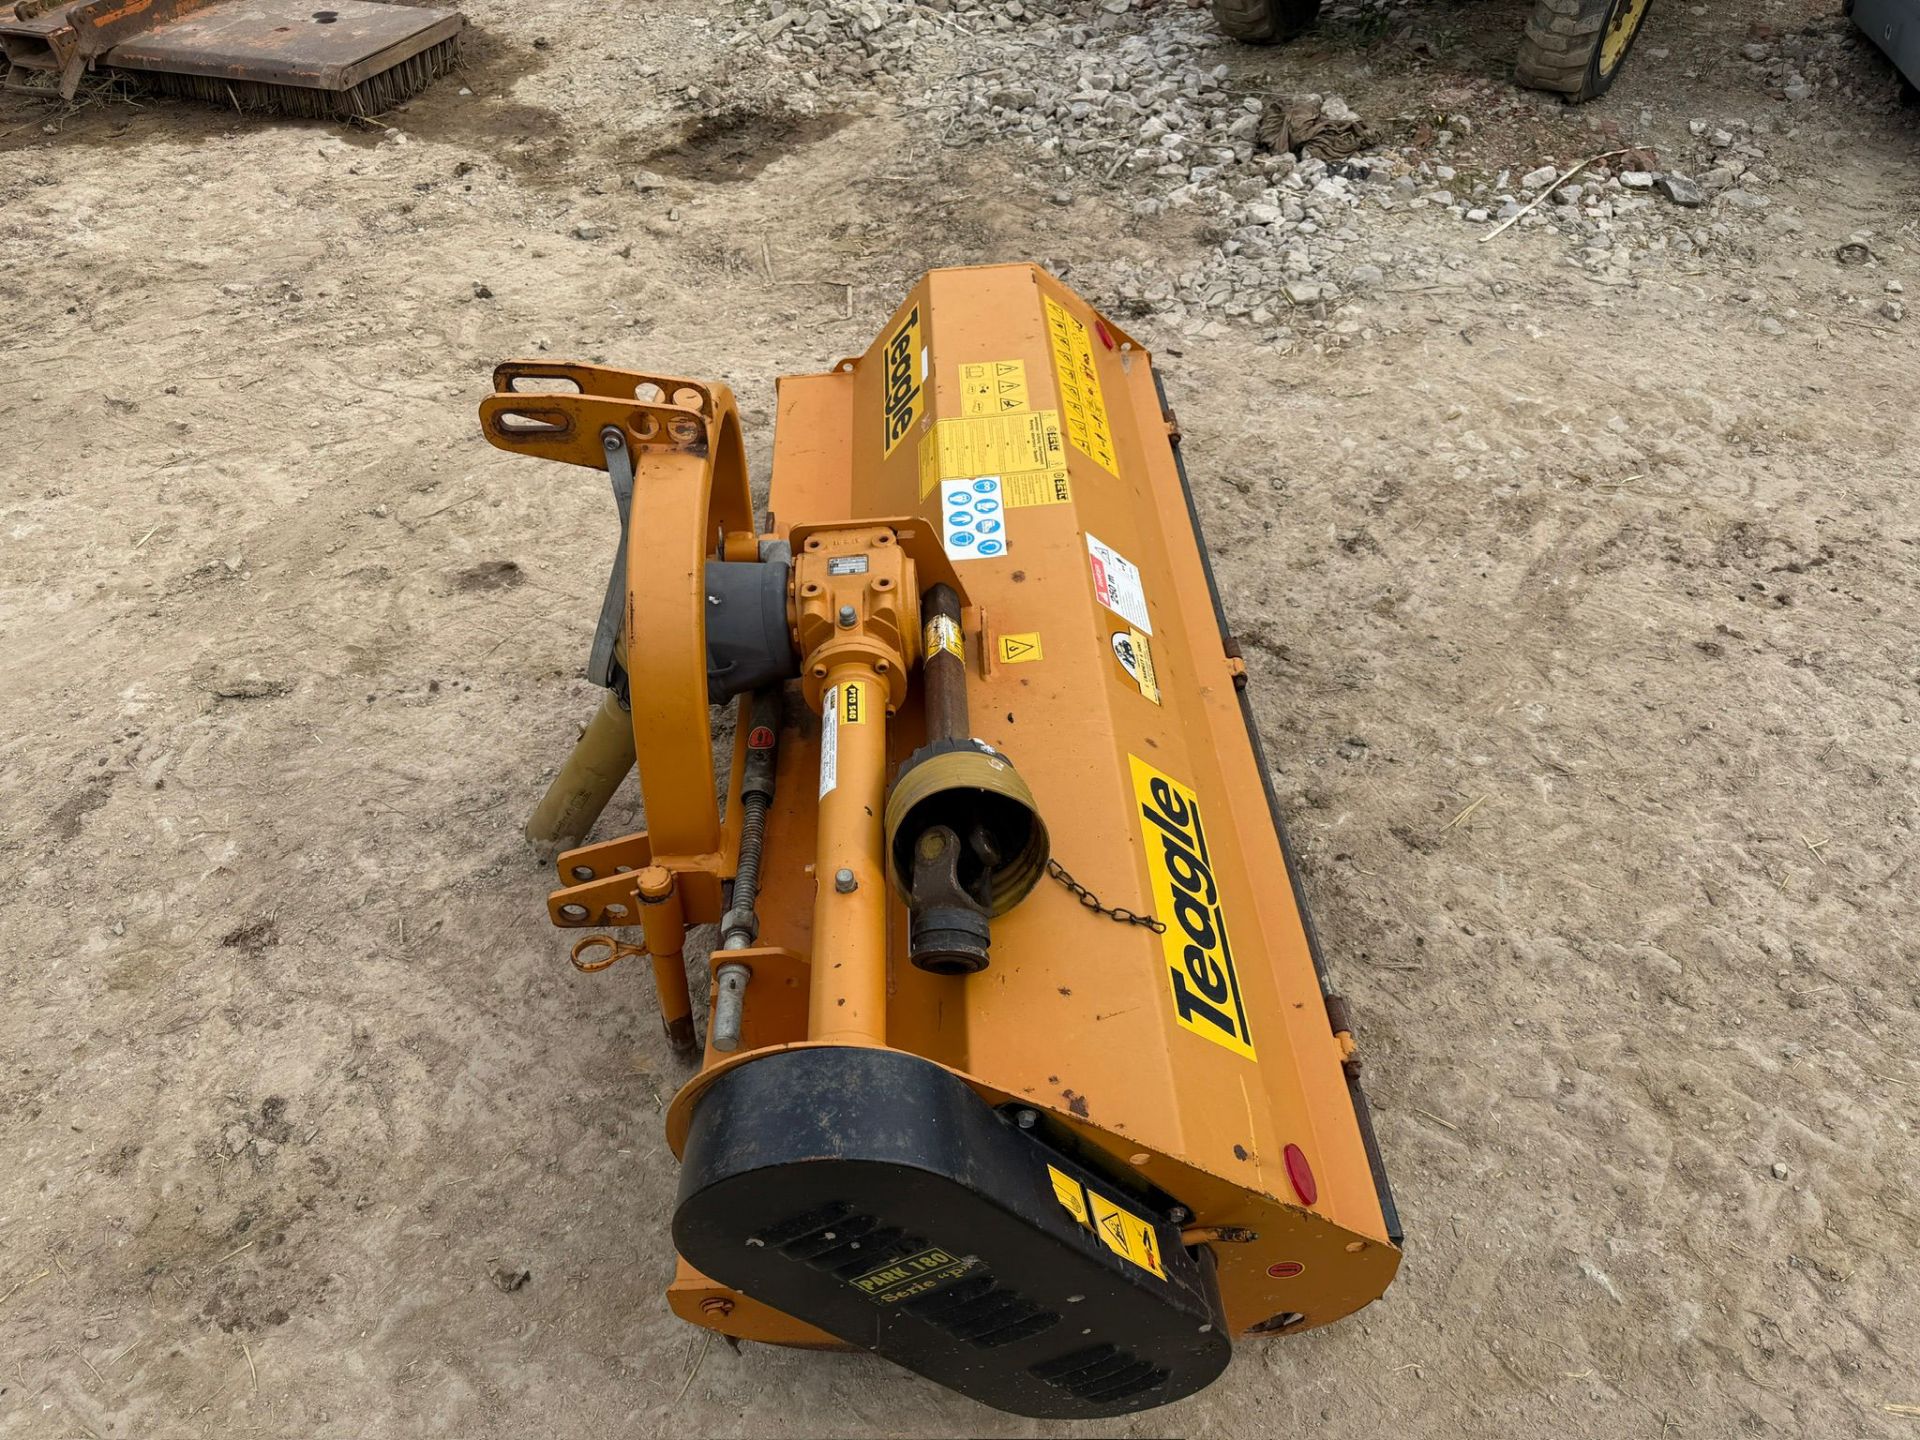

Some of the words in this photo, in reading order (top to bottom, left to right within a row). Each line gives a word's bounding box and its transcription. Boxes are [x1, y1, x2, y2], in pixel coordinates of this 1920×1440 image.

[885, 306, 920, 440] Teagle
[848, 688, 857, 703] PTO
[848, 705, 857, 719] 540
[1142, 777, 1237, 1038] Teagle
[860, 1266, 912, 1290] PARK
[908, 1252, 950, 1271] 180
[881, 1280, 937, 1302] Serie
